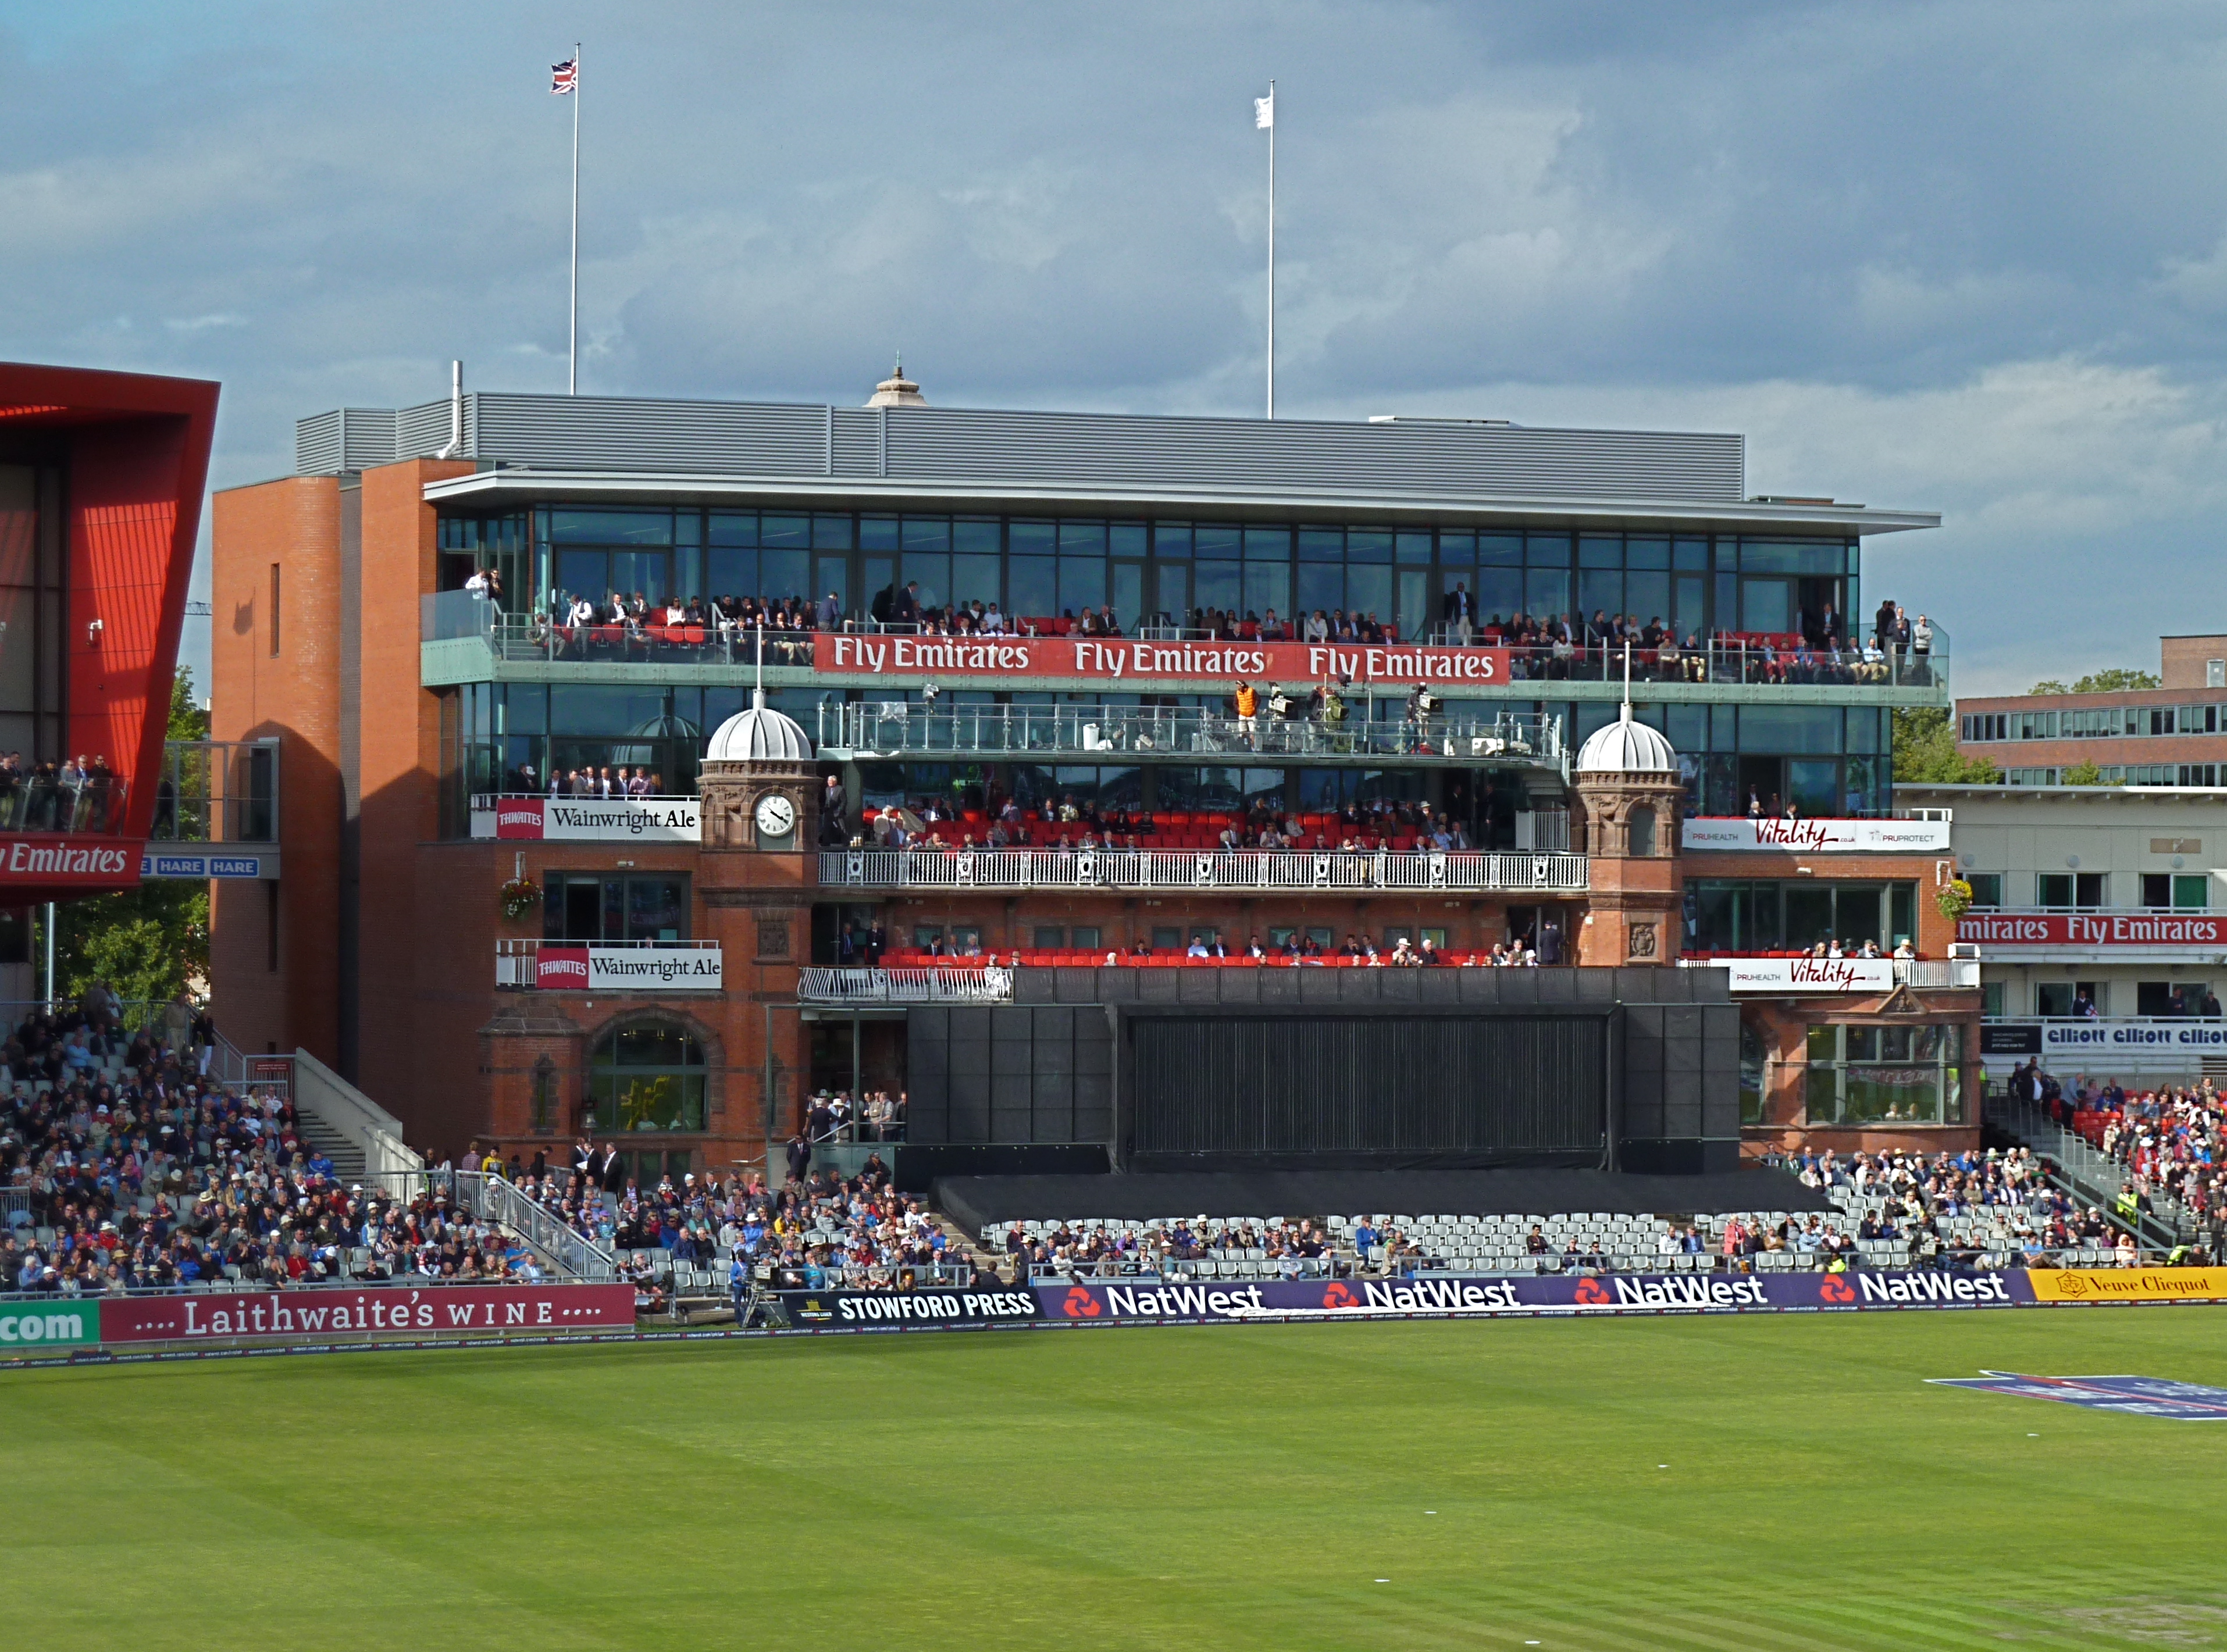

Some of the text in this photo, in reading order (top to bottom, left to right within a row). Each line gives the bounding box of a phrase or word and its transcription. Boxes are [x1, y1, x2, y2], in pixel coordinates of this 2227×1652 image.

[834, 637, 1029, 672] Fly Emirates
[1075, 643, 1264, 676] Fly Emirates
[1309, 647, 1494, 679] Fly Emirates
[500, 811, 542, 826] THWAITES
[551, 808, 696, 834] Wainwright Ale
[1755, 819, 1839, 851] Vitality
[9, 842, 127, 873] Emirates
[161, 861, 201, 872] HARE
[214, 862, 254, 873] HARE
[1957, 916, 2048, 940] mirates
[2067, 916, 2217, 944] Fly Emirates
[539, 959, 586, 976] THWAITES
[590, 958, 720, 981] Wainwright Ale
[1790, 958, 1866, 991] Vitality
[2047, 1028, 2105, 1043] elliott
[2113, 1029, 2171, 1043] elliott
[1363, 1279, 1521, 1308] NatWest
[1613, 1275, 1768, 1304] NatWest
[1858, 1272, 2009, 1301] NatWest
[2089, 1275, 2211, 1294] Veuve Clicquot
[185, 1291, 552, 1335] Laithwaite's WINE
[838, 1291, 1035, 1320] STOWFORD PRESS
[1105, 1284, 1266, 1315] NatWest
